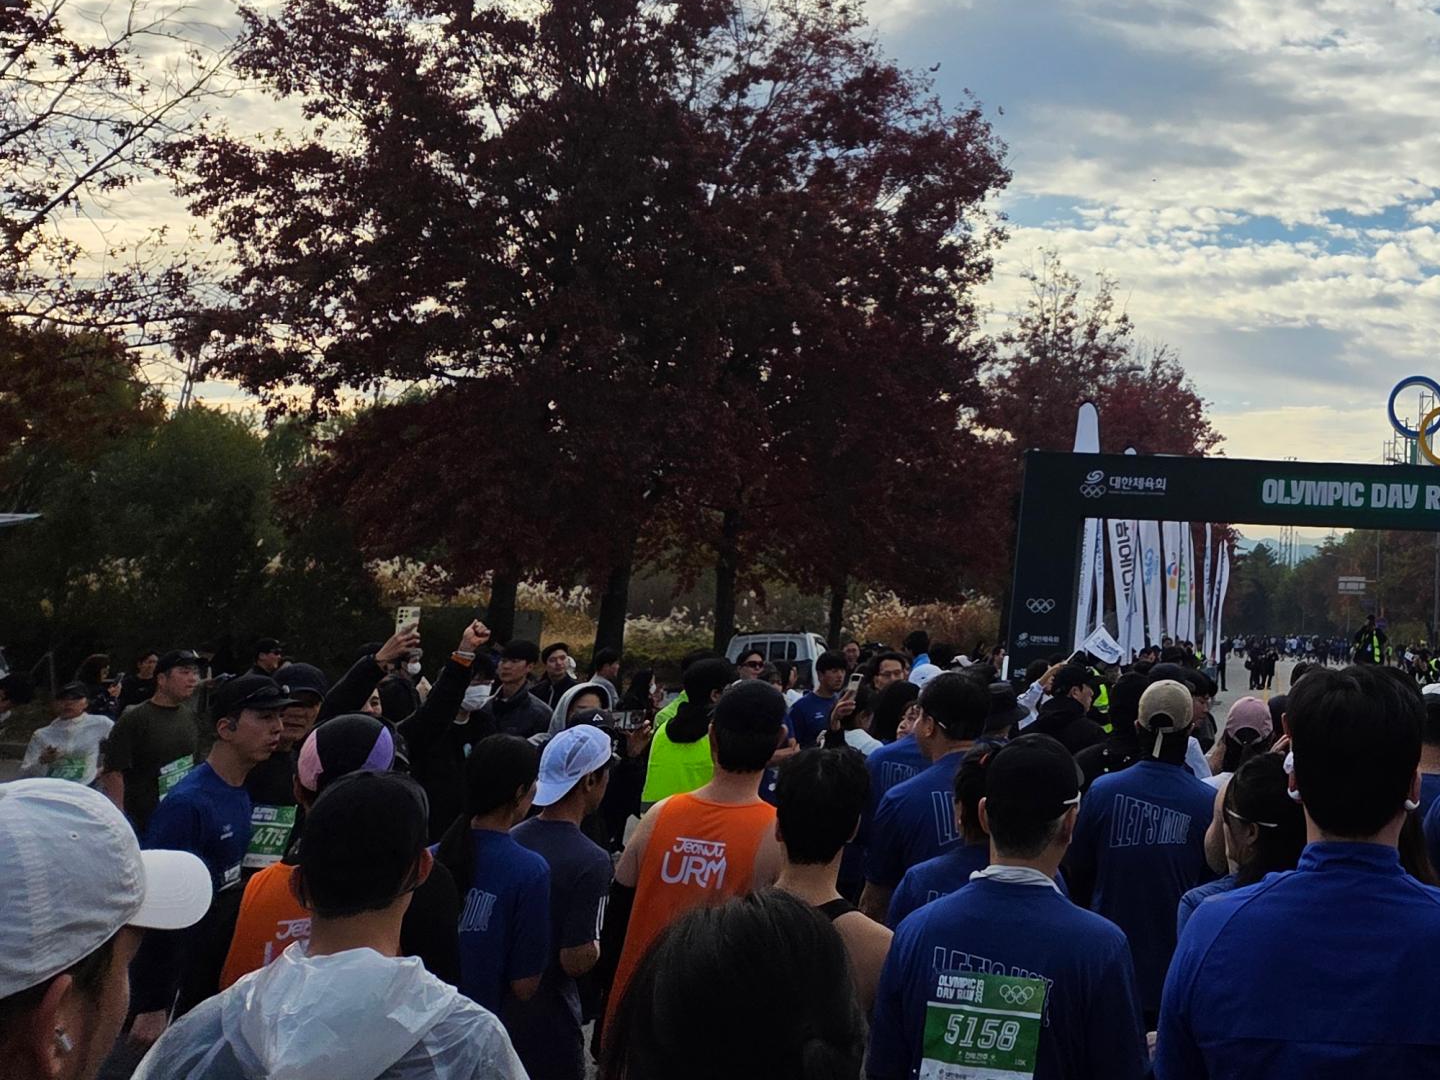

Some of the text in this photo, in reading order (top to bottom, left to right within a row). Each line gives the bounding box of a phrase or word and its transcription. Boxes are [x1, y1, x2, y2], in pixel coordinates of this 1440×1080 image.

[1109, 476, 1167, 490] 대한체육회
[1262, 479, 1365, 507] OLYMPIC
[1371, 483, 1419, 508] DAY
[1110, 793, 1161, 848] LET'S
[661, 852, 727, 889] URM
[936, 986, 975, 1002] DAY RUN
[938, 974, 977, 990] OLYMPIC
[944, 1014, 1020, 1051] 5158
